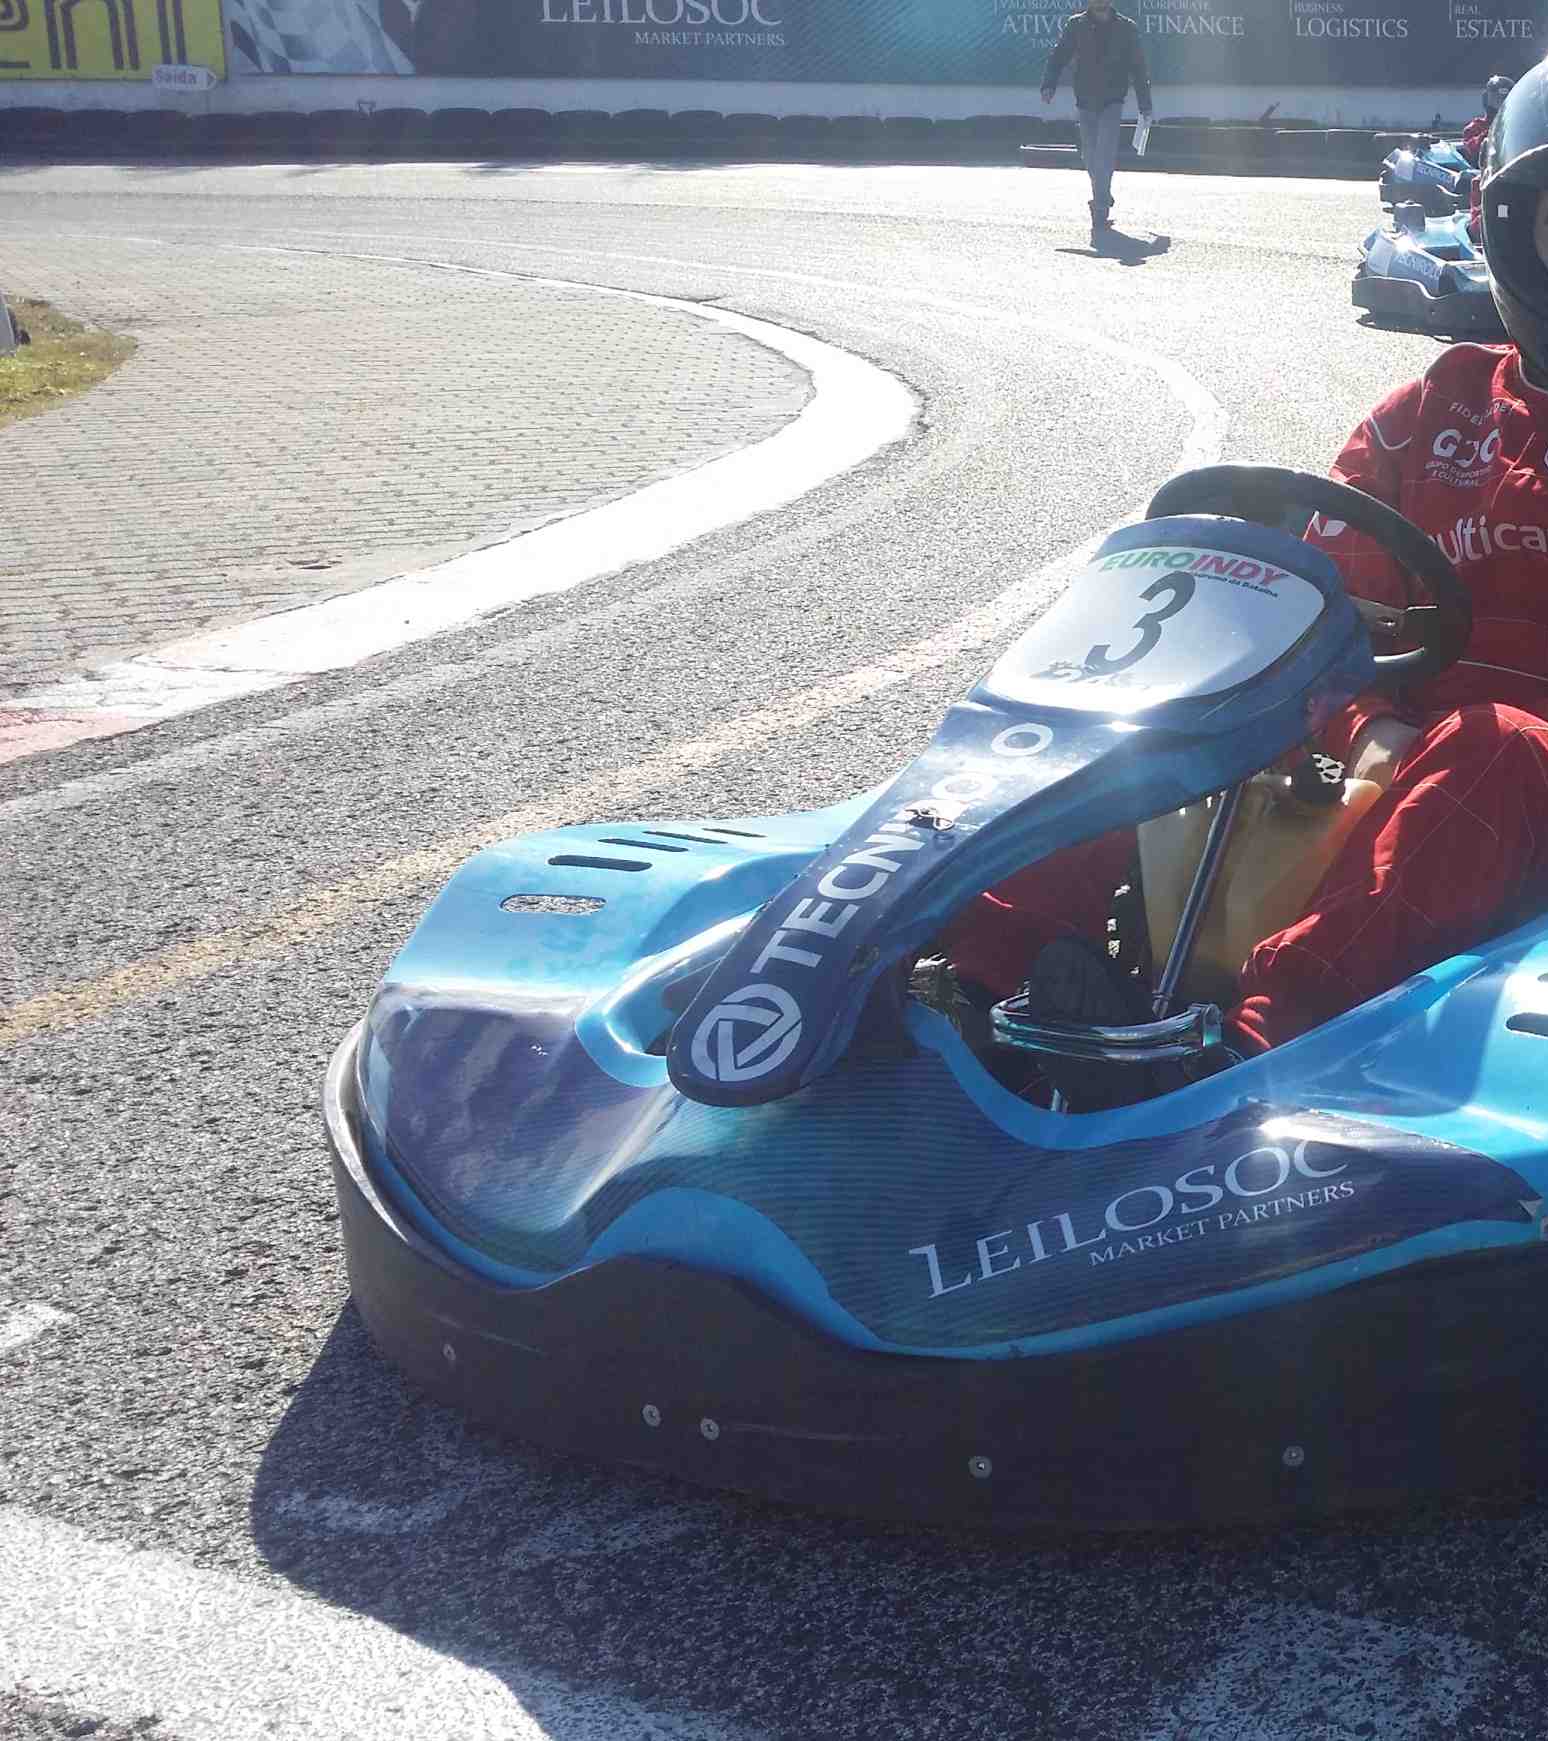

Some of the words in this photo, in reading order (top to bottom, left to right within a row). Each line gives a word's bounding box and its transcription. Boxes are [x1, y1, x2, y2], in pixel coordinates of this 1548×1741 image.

[540, 0, 784, 25] LEILOSOC
[1455, 5, 1481, 15] REAL
[1144, 15, 1245, 36] FINANCE
[1295, 17, 1408, 38] LOGISTICS
[1455, 19, 1534, 39] ESTATE
[635, 31, 701, 45] MARKET
[706, 31, 785, 46] PARTNERS
[1101, 551, 1291, 586] EUROINDY
[1085, 570, 1197, 673] 3
[908, 1139, 1349, 1299] LEILOSOC
[1087, 1217, 1210, 1267] MARKET
[1217, 1180, 1356, 1231] PARTNERS
